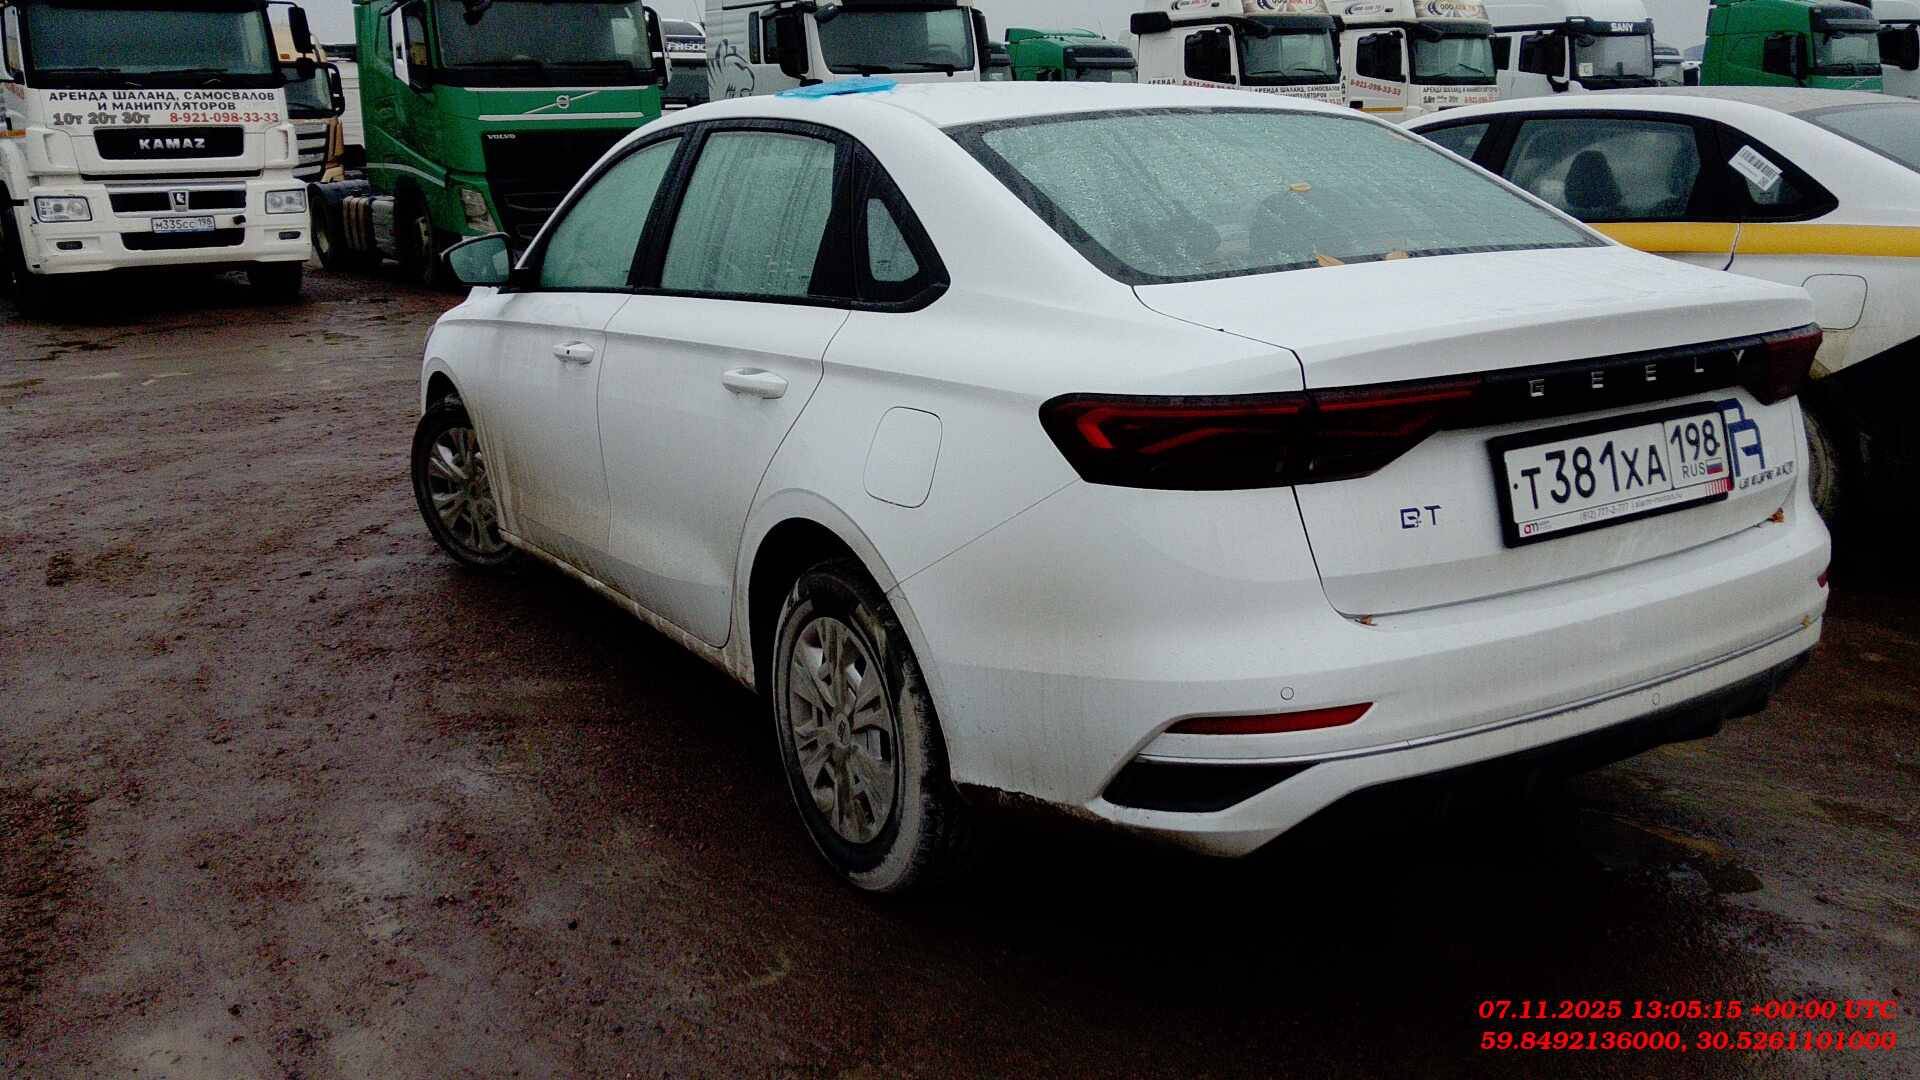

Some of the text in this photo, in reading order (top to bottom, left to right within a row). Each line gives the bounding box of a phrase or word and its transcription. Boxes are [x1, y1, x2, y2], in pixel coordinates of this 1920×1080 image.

[1611, 22, 1633, 32] SANY
[49, 91, 275, 101] АРЕНДА ШАЛАНД, САМОСВАЛОВ
[98, 101, 236, 110] И МАНИПУЛЯТОРОВ
[53, 112, 151, 125] 10т 20т 30т
[170, 112, 279, 122] 8-921-098-33-33
[139, 138, 205, 149] KAMAZ
[1529, 350, 1744, 397] GEELY
[1671, 420, 1720, 463] 198
[1682, 464, 1706, 478] RUS
